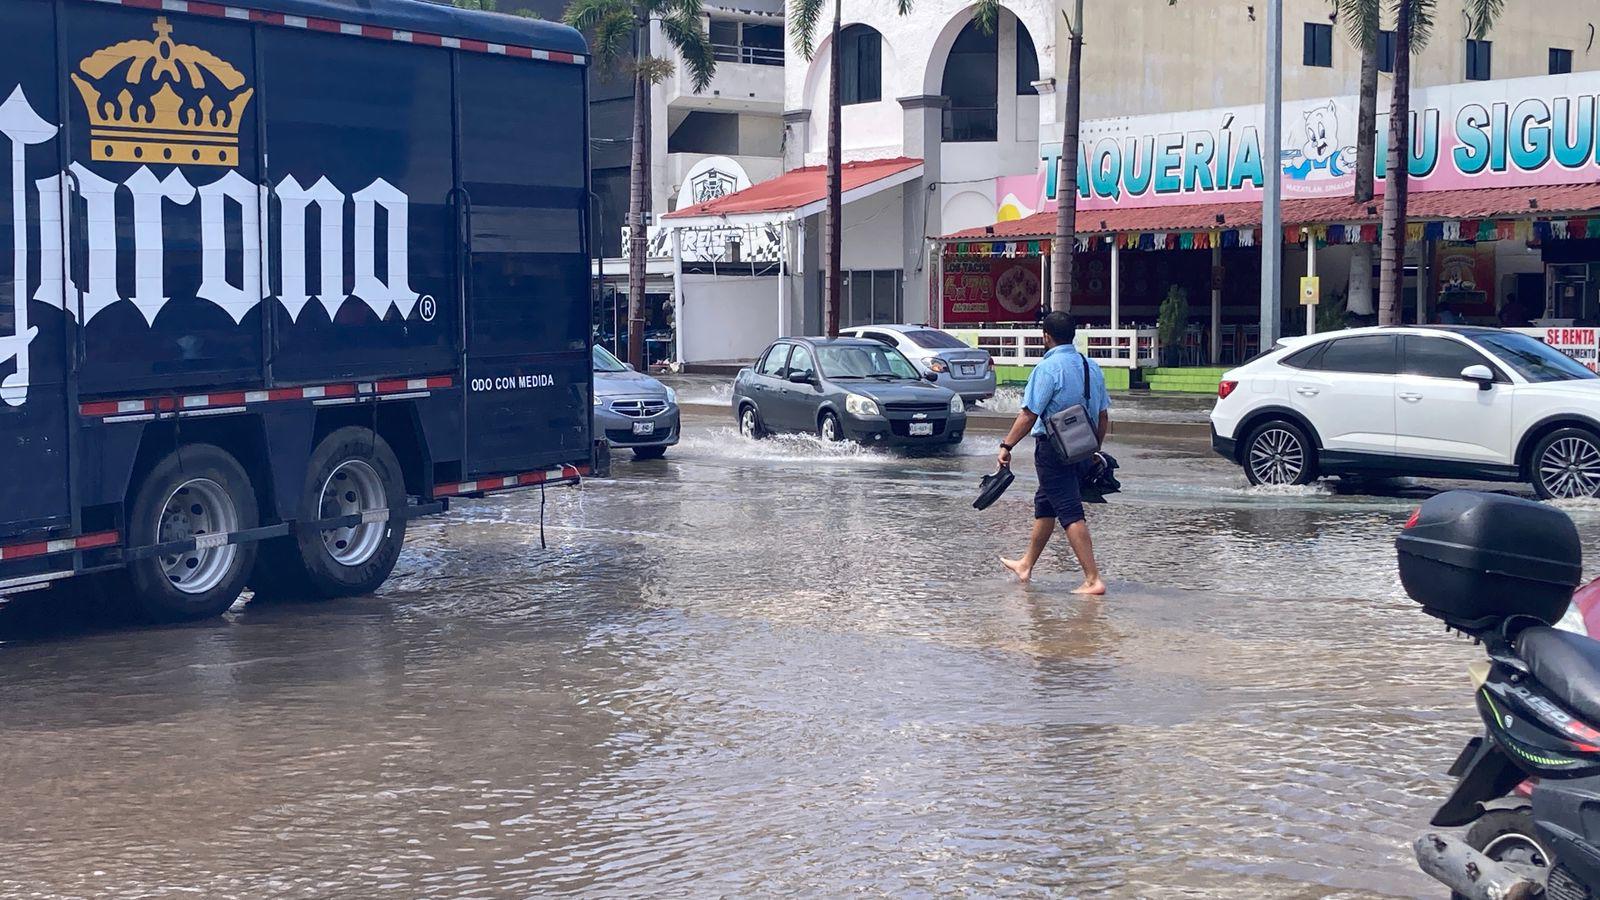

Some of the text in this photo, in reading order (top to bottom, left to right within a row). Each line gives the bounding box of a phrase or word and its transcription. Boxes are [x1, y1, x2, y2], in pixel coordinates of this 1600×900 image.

[1454, 95, 1600, 174] SIGU
[1547, 329, 1595, 345] SE RENTA
[471, 374, 555, 392] ODO CON MEDIDA
